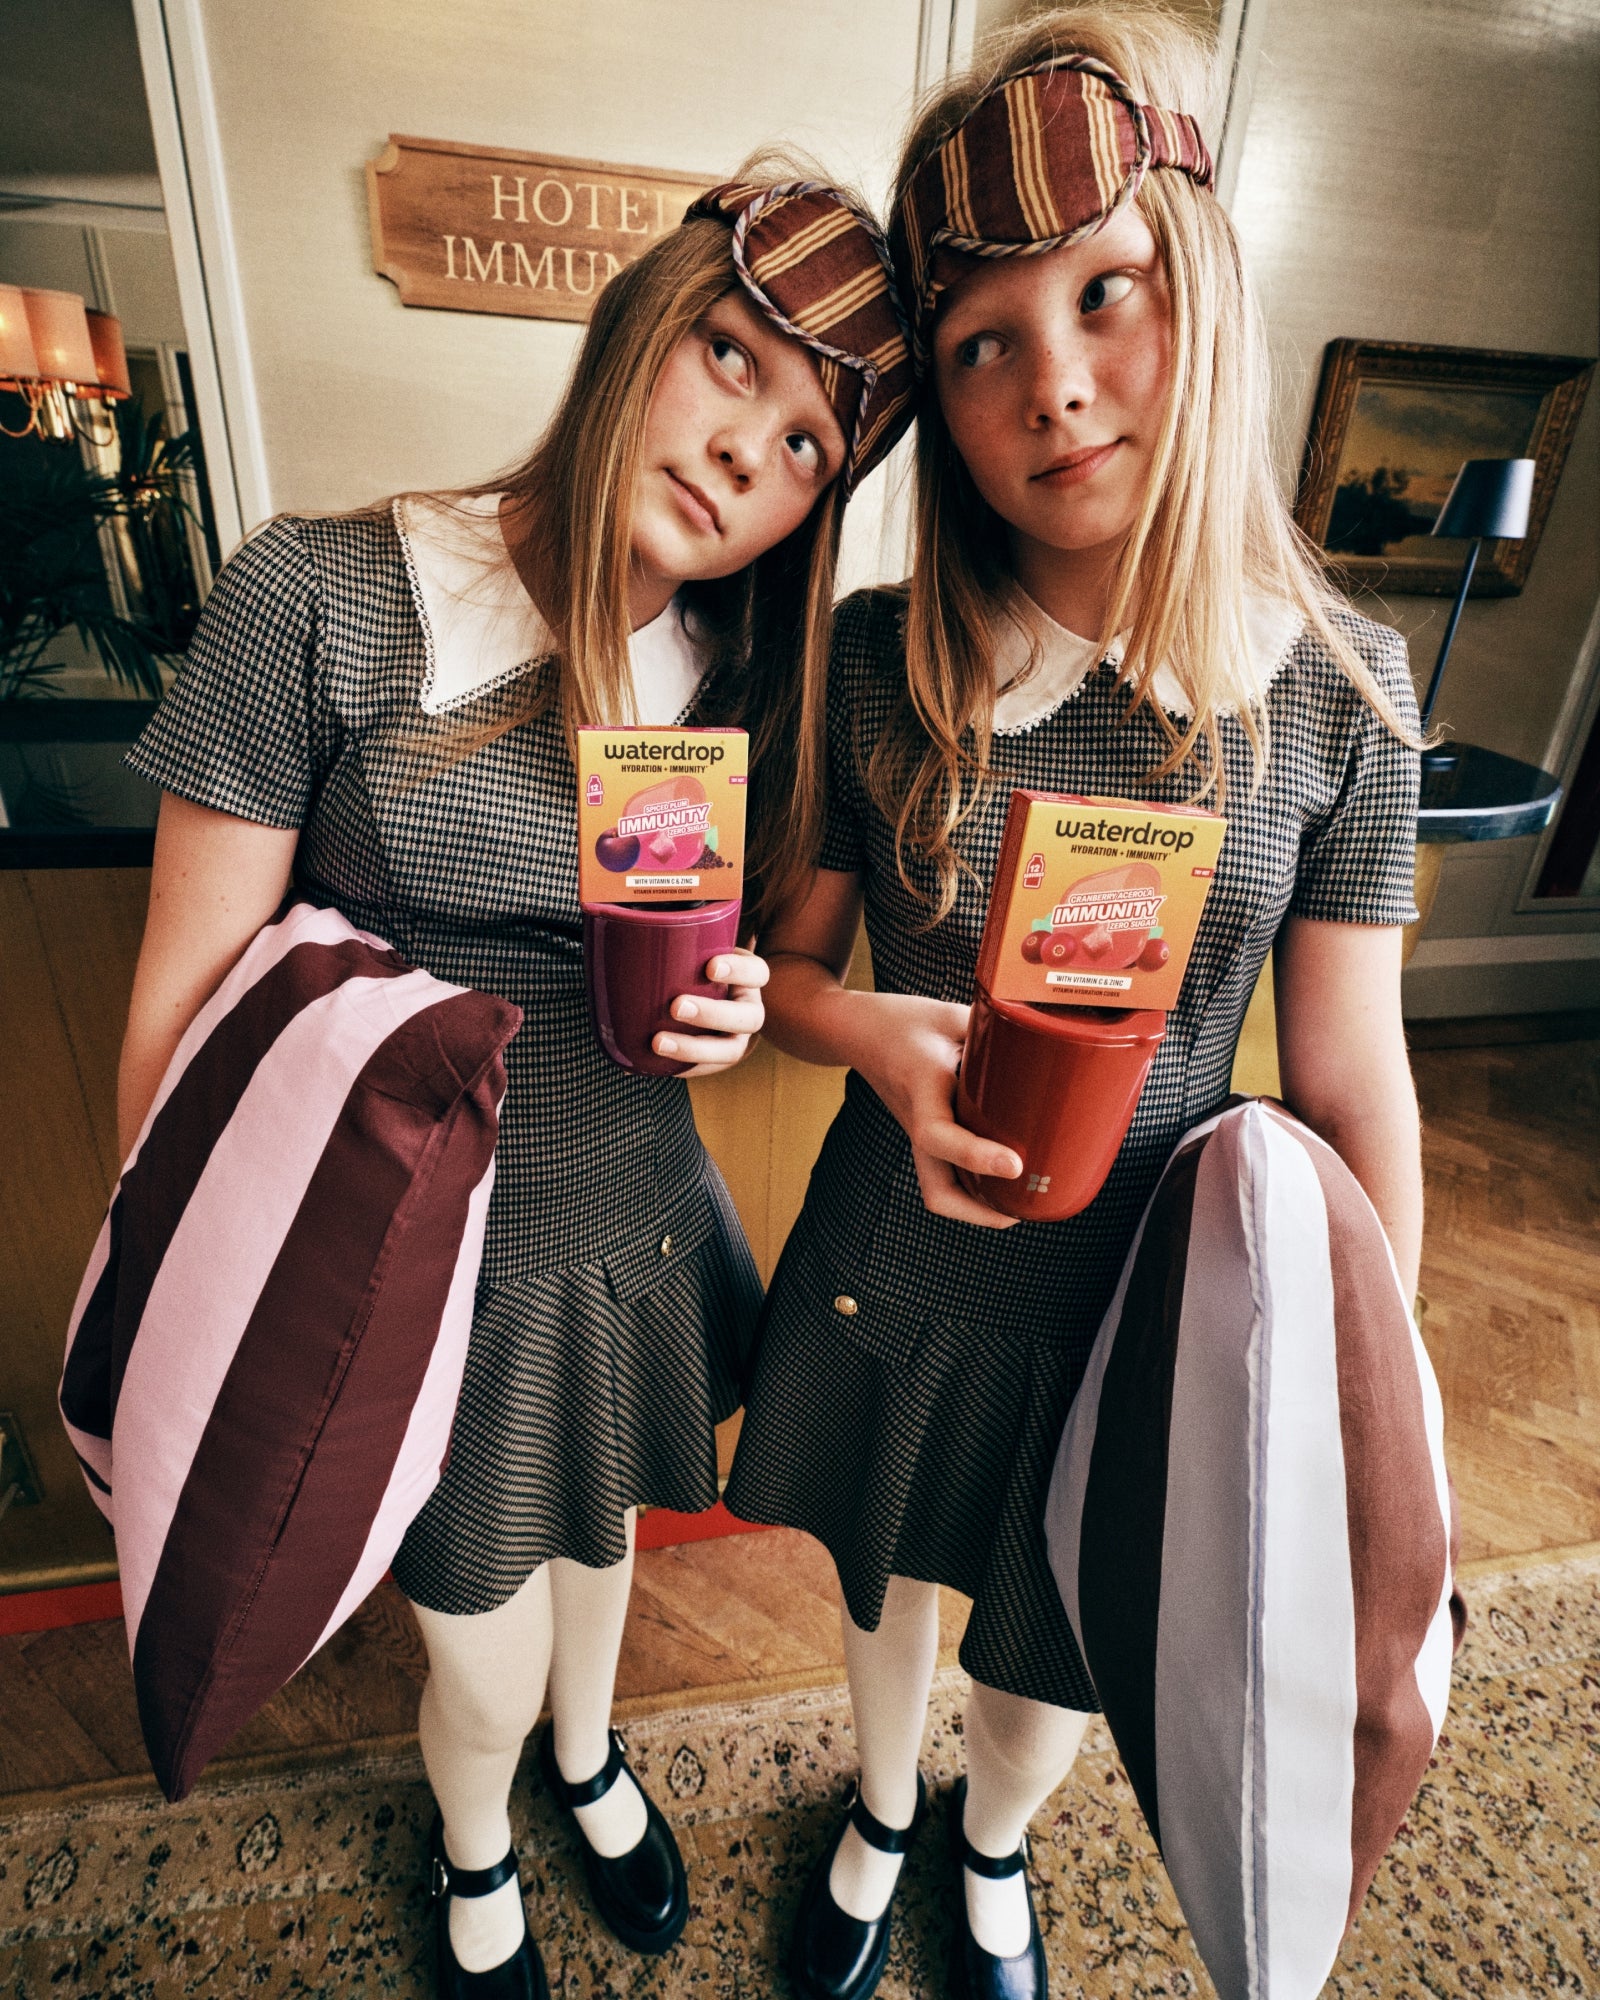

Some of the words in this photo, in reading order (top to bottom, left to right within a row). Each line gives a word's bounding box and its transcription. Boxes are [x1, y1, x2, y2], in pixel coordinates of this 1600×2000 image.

[604, 740, 725, 765] waterdrop
[621, 764, 662, 773] HYDRATION
[669, 765, 706, 774] IMMUNITY
[645, 803, 669, 814] SPICED
[669, 800, 689, 810] PLUM
[620, 805, 709, 835] IMMUNITY
[668, 827, 686, 837] ZERO
[686, 822, 709, 833] SUGAR
[1055, 819, 1194, 853] waterdrop
[1070, 844, 1118, 857] HYDRATION
[1126, 849, 1168, 861] IMMUNITY
[1030, 864, 1041, 873] 12
[1070, 893, 1117, 904] CRANBERRY
[1118, 889, 1154, 900] ACEROLA
[1053, 899, 1161, 925] IMMUNITY
[1109, 921, 1129, 930] ZERO
[1130, 918, 1157, 928] SUGAR
[1056, 975, 1072, 983] WITH
[1073, 976, 1097, 985] VITAMIN
[1109, 979, 1124, 987] ZINC
